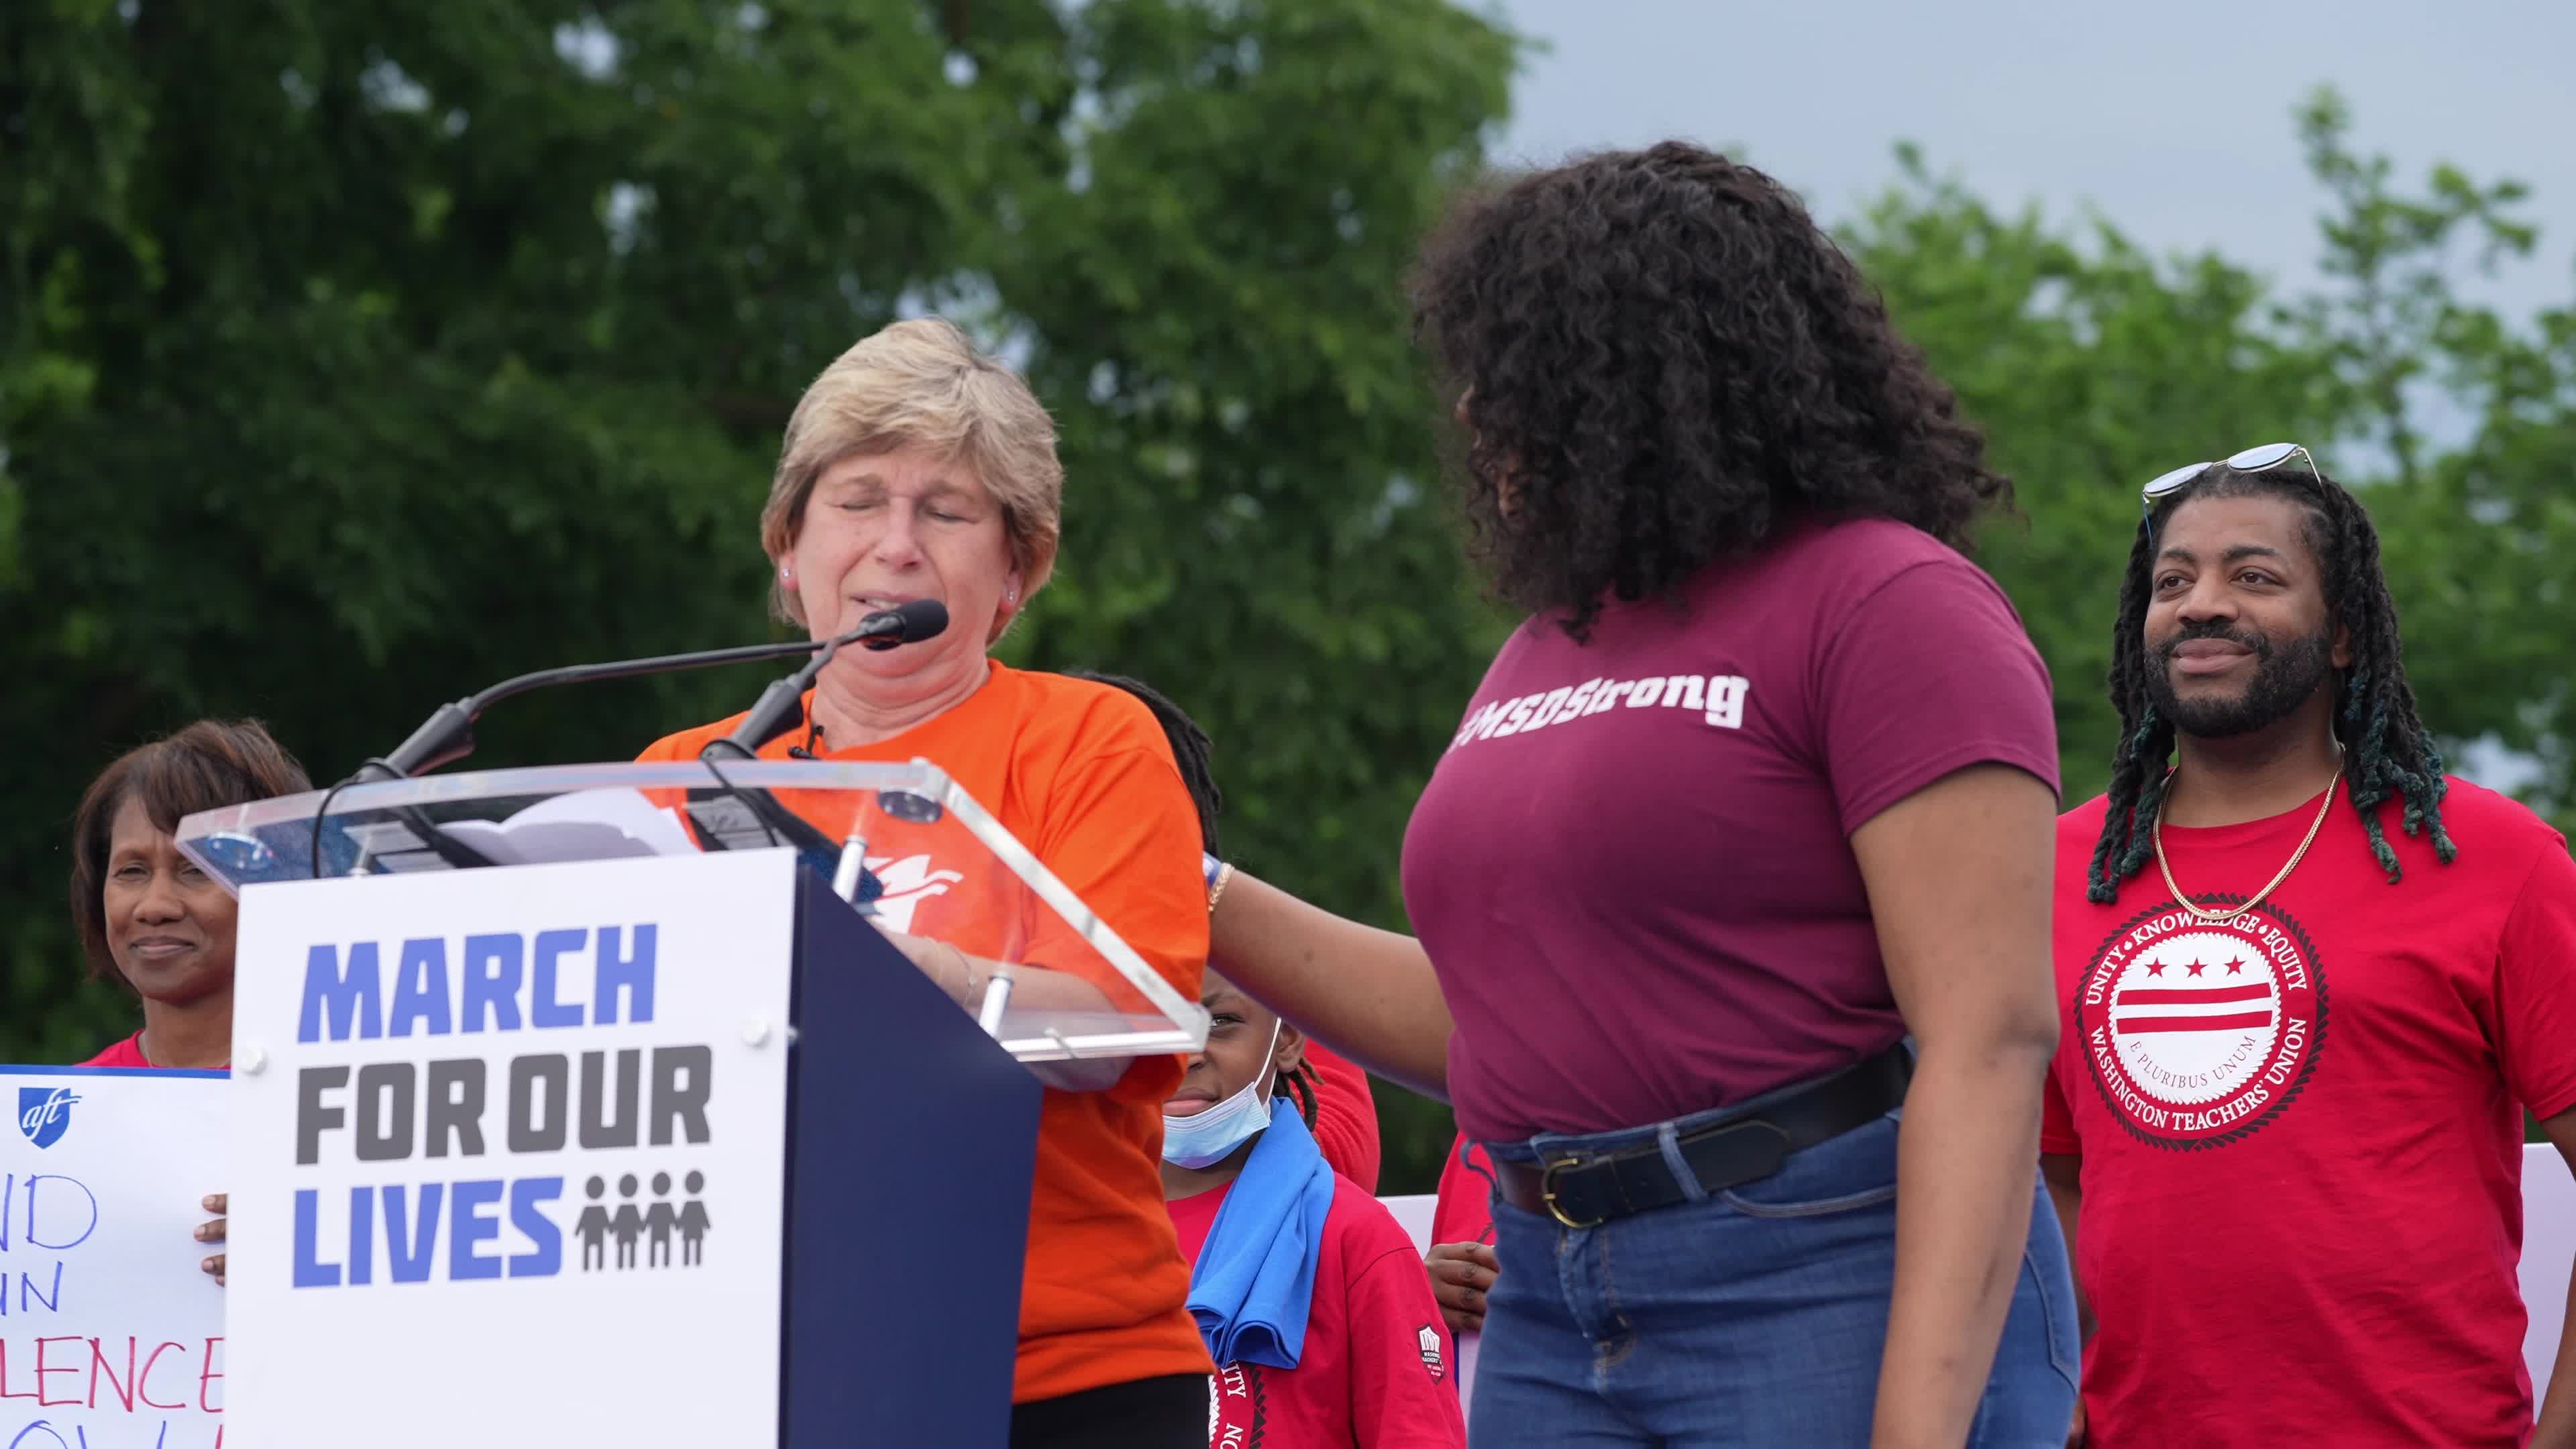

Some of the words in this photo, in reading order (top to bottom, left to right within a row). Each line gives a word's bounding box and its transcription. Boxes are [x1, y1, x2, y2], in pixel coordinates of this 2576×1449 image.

[298, 923, 657, 1044] MARCH
[2086, 945, 2125, 1006] UNITY
[2261, 928, 2307, 991] EQUITY
[21, 1087, 83, 1142] aft
[296, 1058, 486, 1165] FOR
[507, 1044, 712, 1154] OUR
[2090, 1026, 2169, 1130] WASHINGTON
[2264, 1018, 2307, 1085] UNION
[2130, 1040, 2142, 1053] E
[2137, 1053, 2208, 1088] PLURIBUS
[2212, 1035, 2257, 1080] UNUM
[292, 1176, 564, 1289] LIVES
